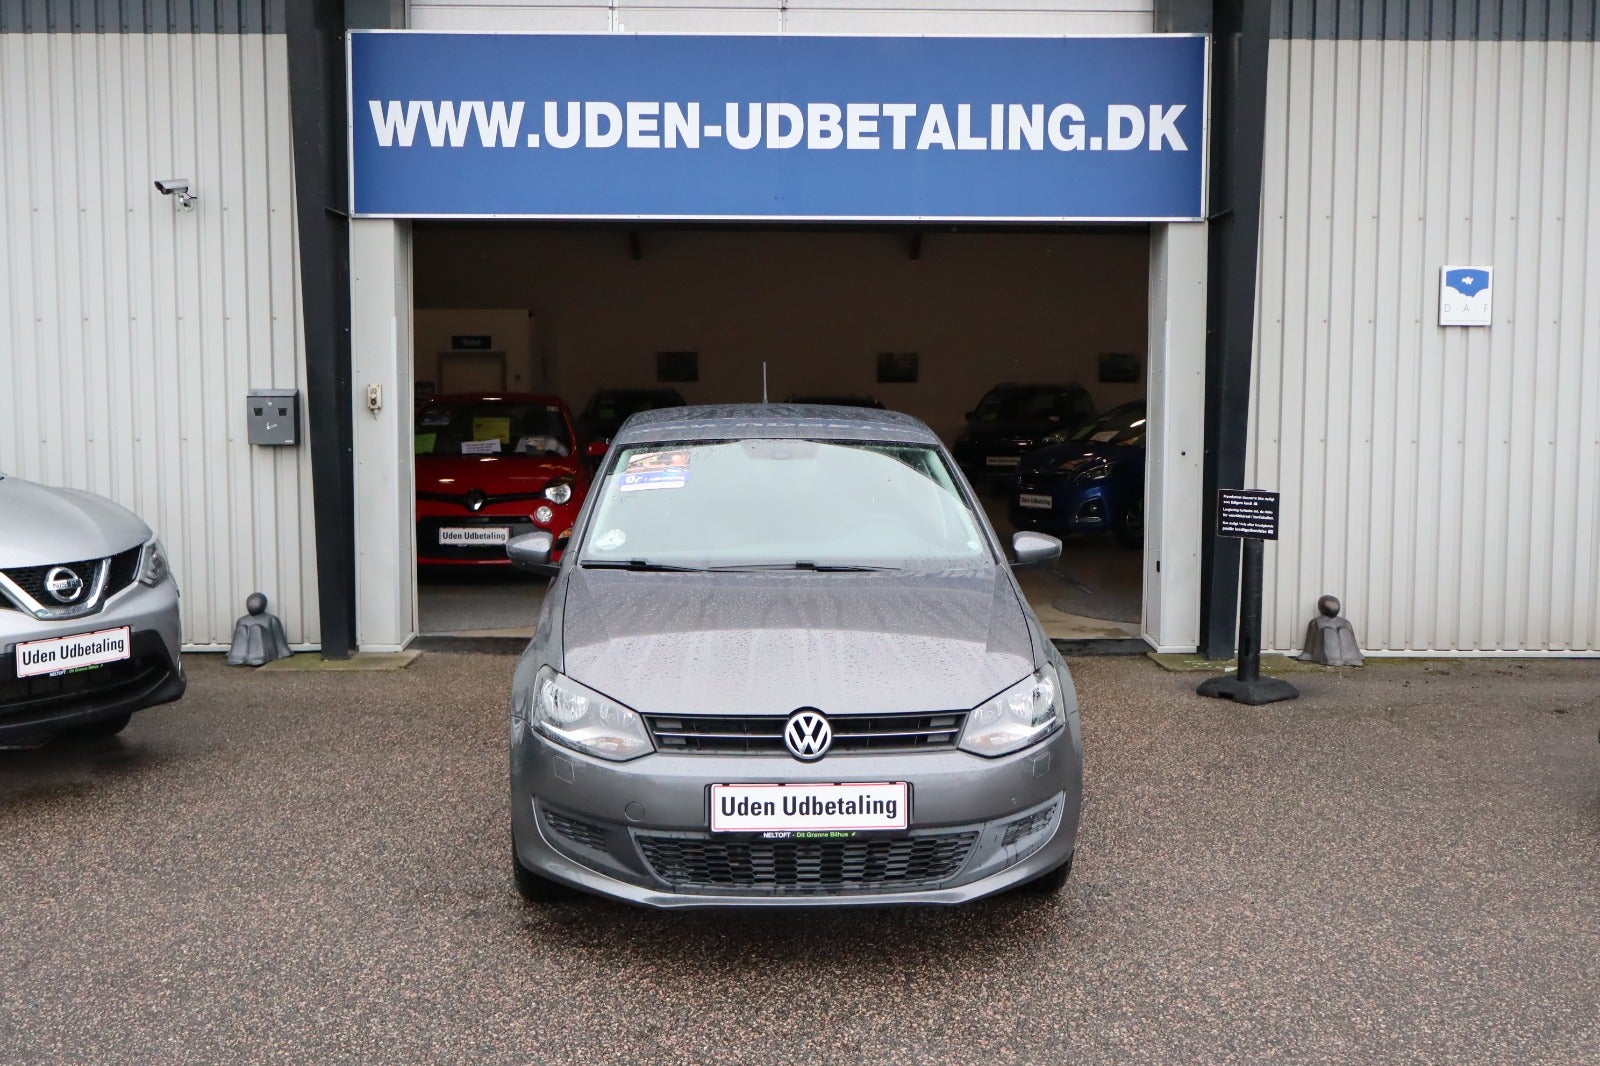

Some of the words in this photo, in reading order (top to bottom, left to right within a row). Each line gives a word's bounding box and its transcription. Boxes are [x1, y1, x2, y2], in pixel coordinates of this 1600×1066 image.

[368, 99, 1189, 152] WWW.UDEN-UDBETALING.DK
[442, 532, 462, 540] Uden
[464, 531, 506, 541] Udbetaling
[22, 649, 56, 666] Uden
[60, 637, 125, 660] Udbetaling
[721, 796, 775, 816] Uden
[782, 794, 898, 819] Udbetaling
[763, 831, 791, 839] NELTOFT
